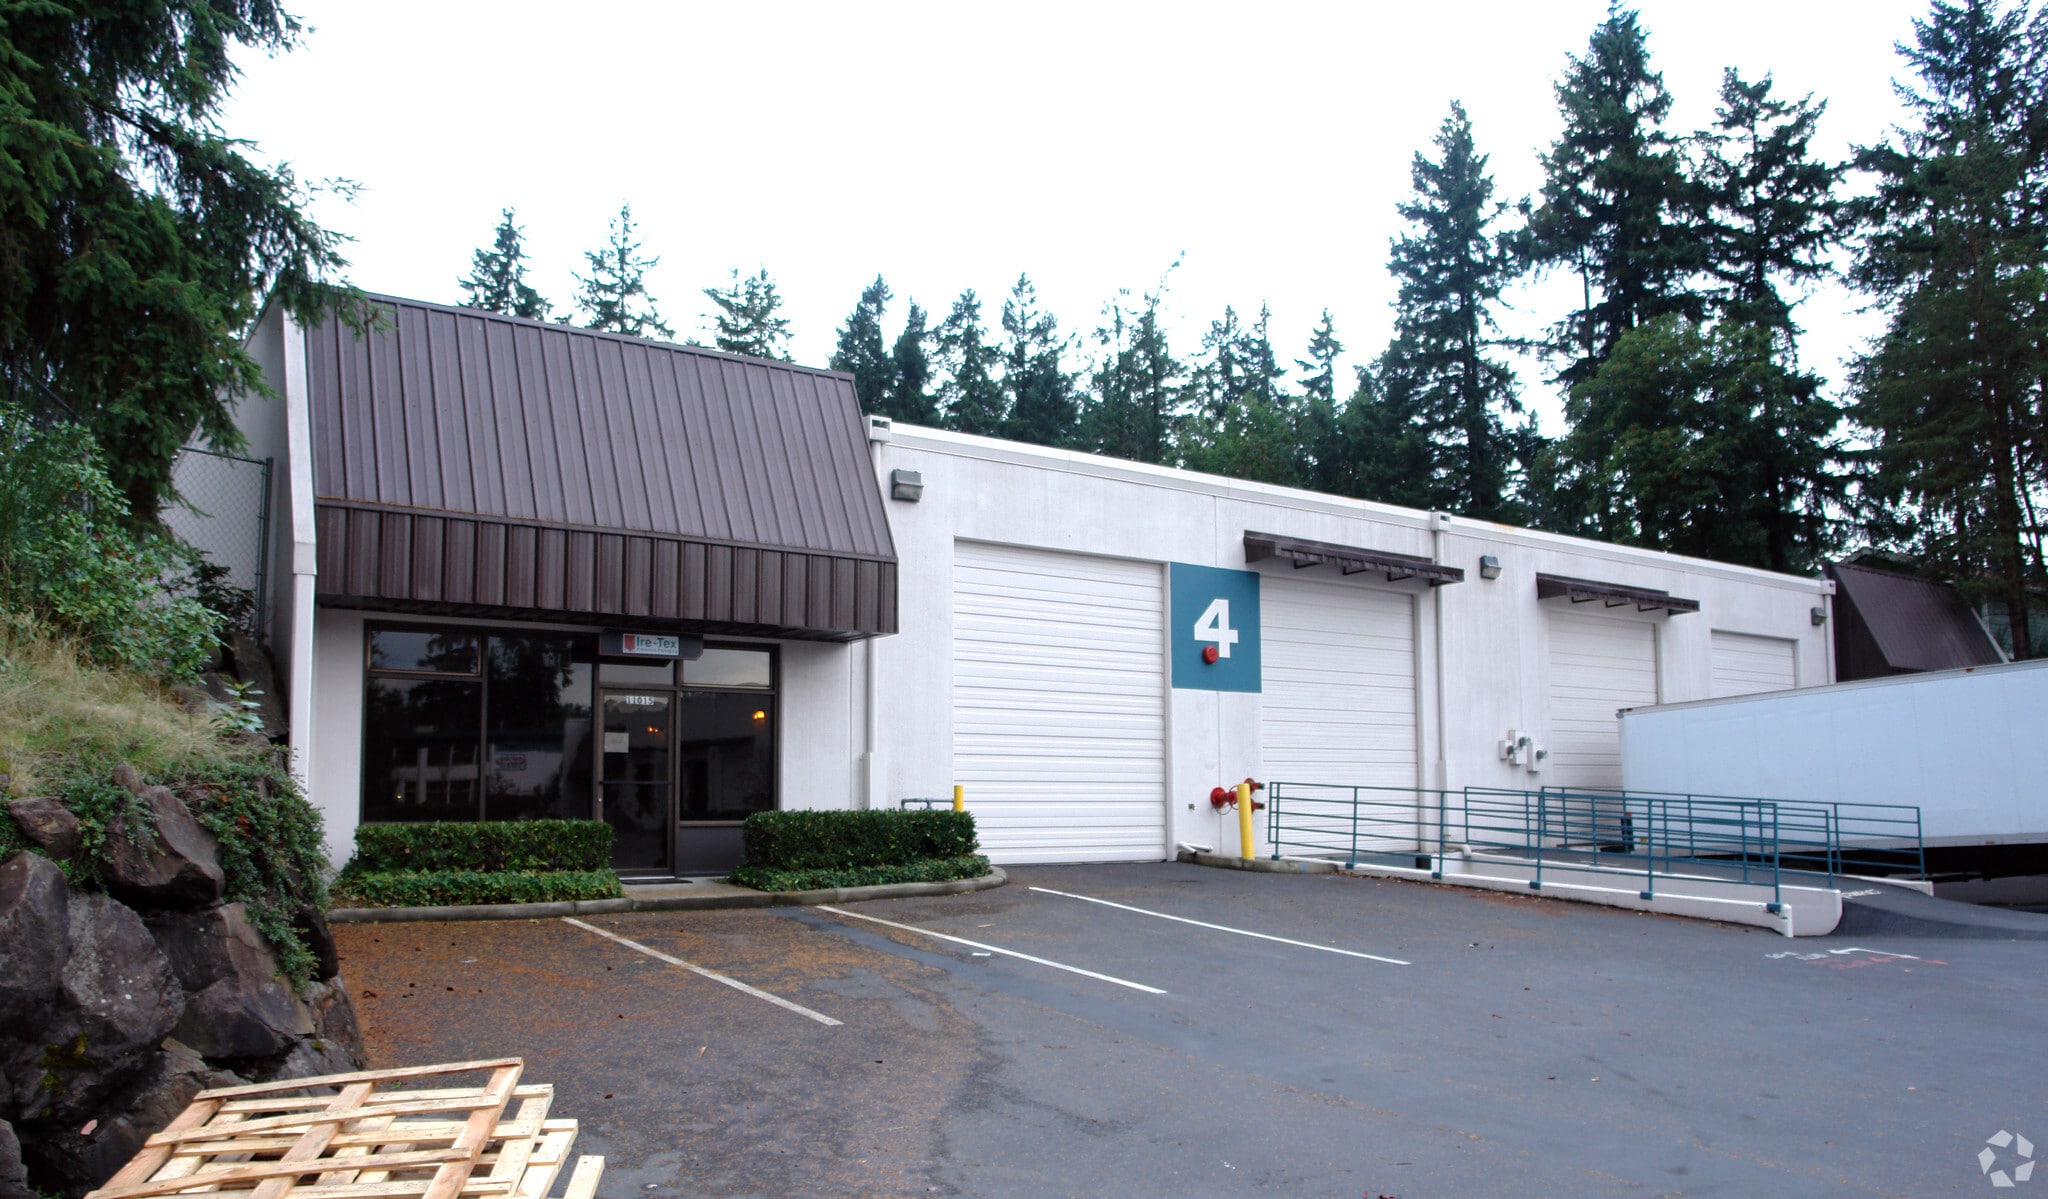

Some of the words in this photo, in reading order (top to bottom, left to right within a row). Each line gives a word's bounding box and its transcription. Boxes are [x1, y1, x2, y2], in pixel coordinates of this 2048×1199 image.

[1194, 599, 1238, 658] 4
[636, 636, 676, 648] Ire-Tex
[627, 695, 654, 705] 11015
